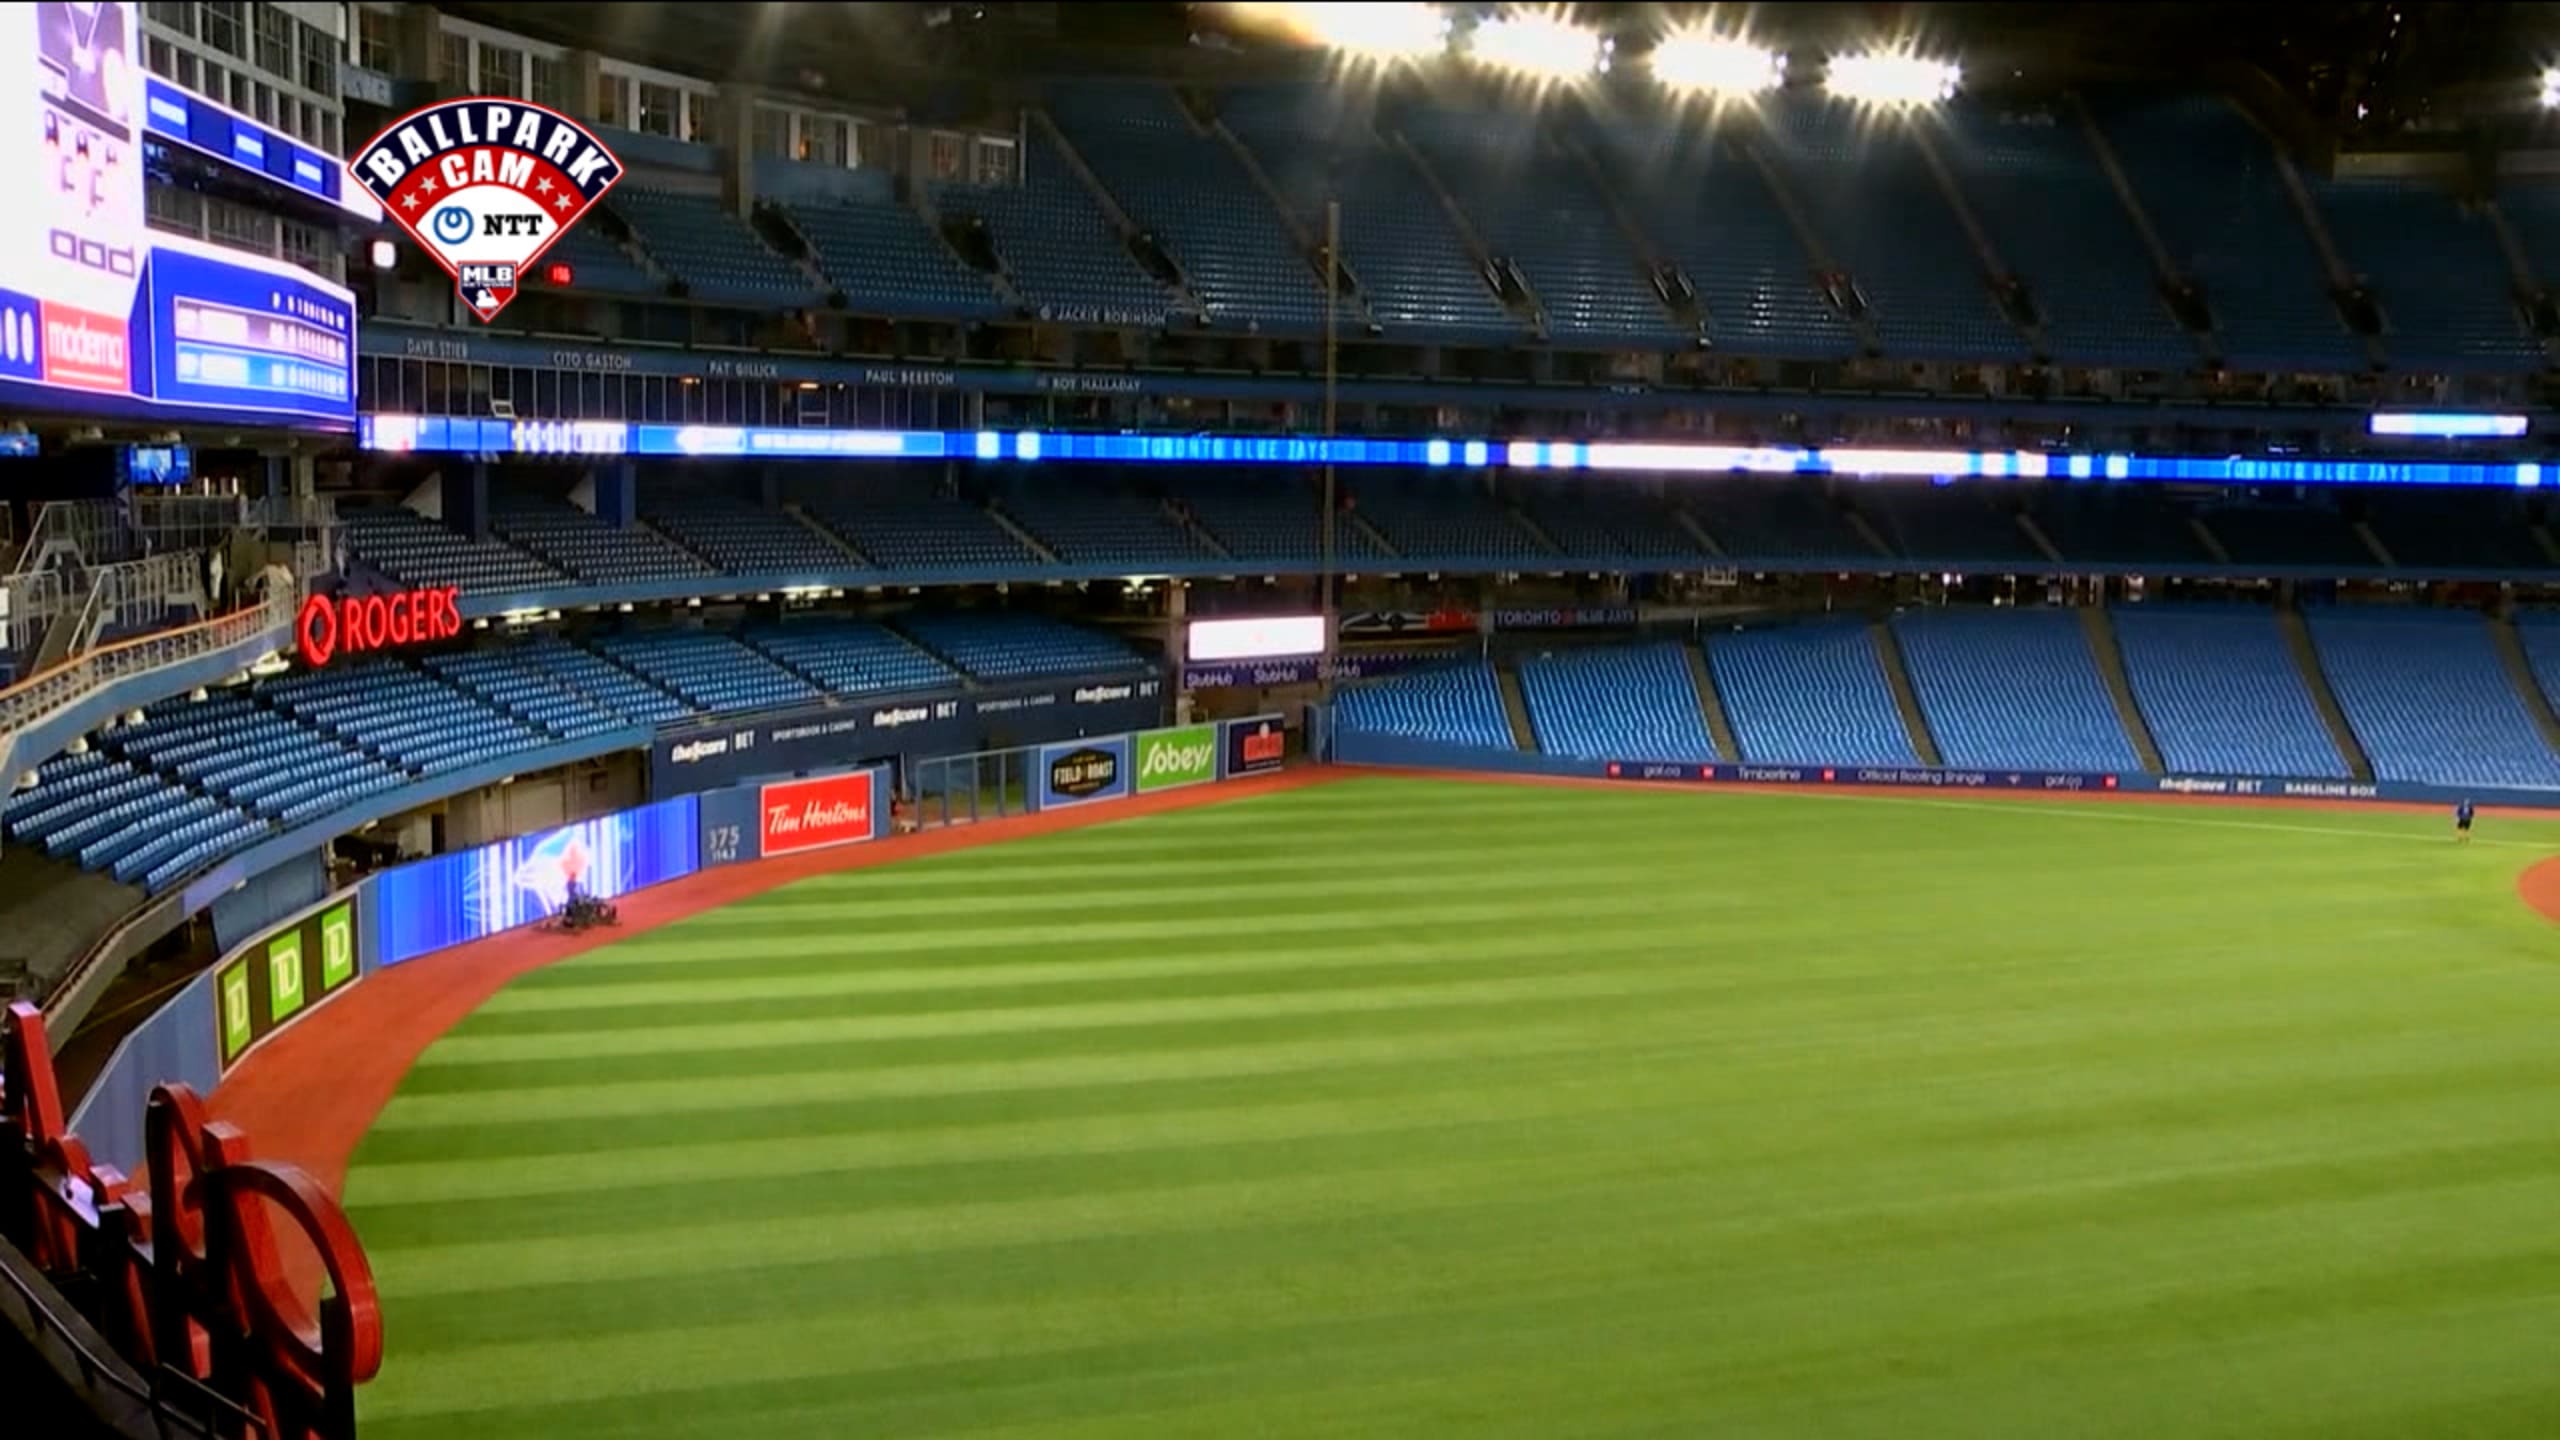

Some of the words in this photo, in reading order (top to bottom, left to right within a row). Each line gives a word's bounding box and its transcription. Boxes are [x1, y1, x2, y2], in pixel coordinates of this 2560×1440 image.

[1057, 307, 1099, 322] JACKIE
[1104, 308, 1166, 325] ROBINSON
[48, 316, 124, 368] moderna
[407, 338, 435, 355] DAVE
[554, 351, 580, 366] CITO
[585, 353, 631, 369] GASTON
[709, 361, 730, 375] PAT
[735, 363, 778, 378] GILLICK
[865, 370, 895, 383] PAUL
[901, 371, 954, 385] BEESTON
[1052, 378, 1076, 390] ROY
[1081, 378, 1142, 391] HALLADAY
[1141, 437, 1224, 460] TORONTO
[1233, 439, 1278, 460] BLUE
[1288, 440, 1328, 461] JAYS
[2224, 461, 2305, 480] TORONTO
[2313, 462, 2357, 481] BLUE
[2368, 464, 2411, 482] JAYS
[343, 585, 461, 652] ROGERS
[1497, 610, 1561, 626] TORONTO
[1186, 672, 1234, 688] StubHub
[1253, 668, 1298, 684] StubHub
[1317, 663, 1362, 679] SbHub
[1074, 685, 1132, 703] theScore
[1139, 681, 1160, 697] BET
[872, 705, 928, 728] theScore
[937, 702, 959, 718] BET
[671, 738, 728, 763] theScore
[734, 730, 755, 751] BET
[1141, 741, 1213, 778] Sobeys
[1054, 765, 1081, 786] FIELD
[1087, 759, 1114, 780] ROAST
[1737, 766, 1801, 781] Timberline
[2159, 778, 2227, 793] theScore
[2237, 780, 2263, 793] BET
[2285, 782, 2347, 795] BASELINE
[2350, 784, 2378, 797] BOX
[768, 804, 800, 835] Tim
[801, 800, 867, 831] Hortons
[324, 920, 349, 970] TD
[271, 947, 299, 1000] TD
[226, 979, 247, 1036] TD
